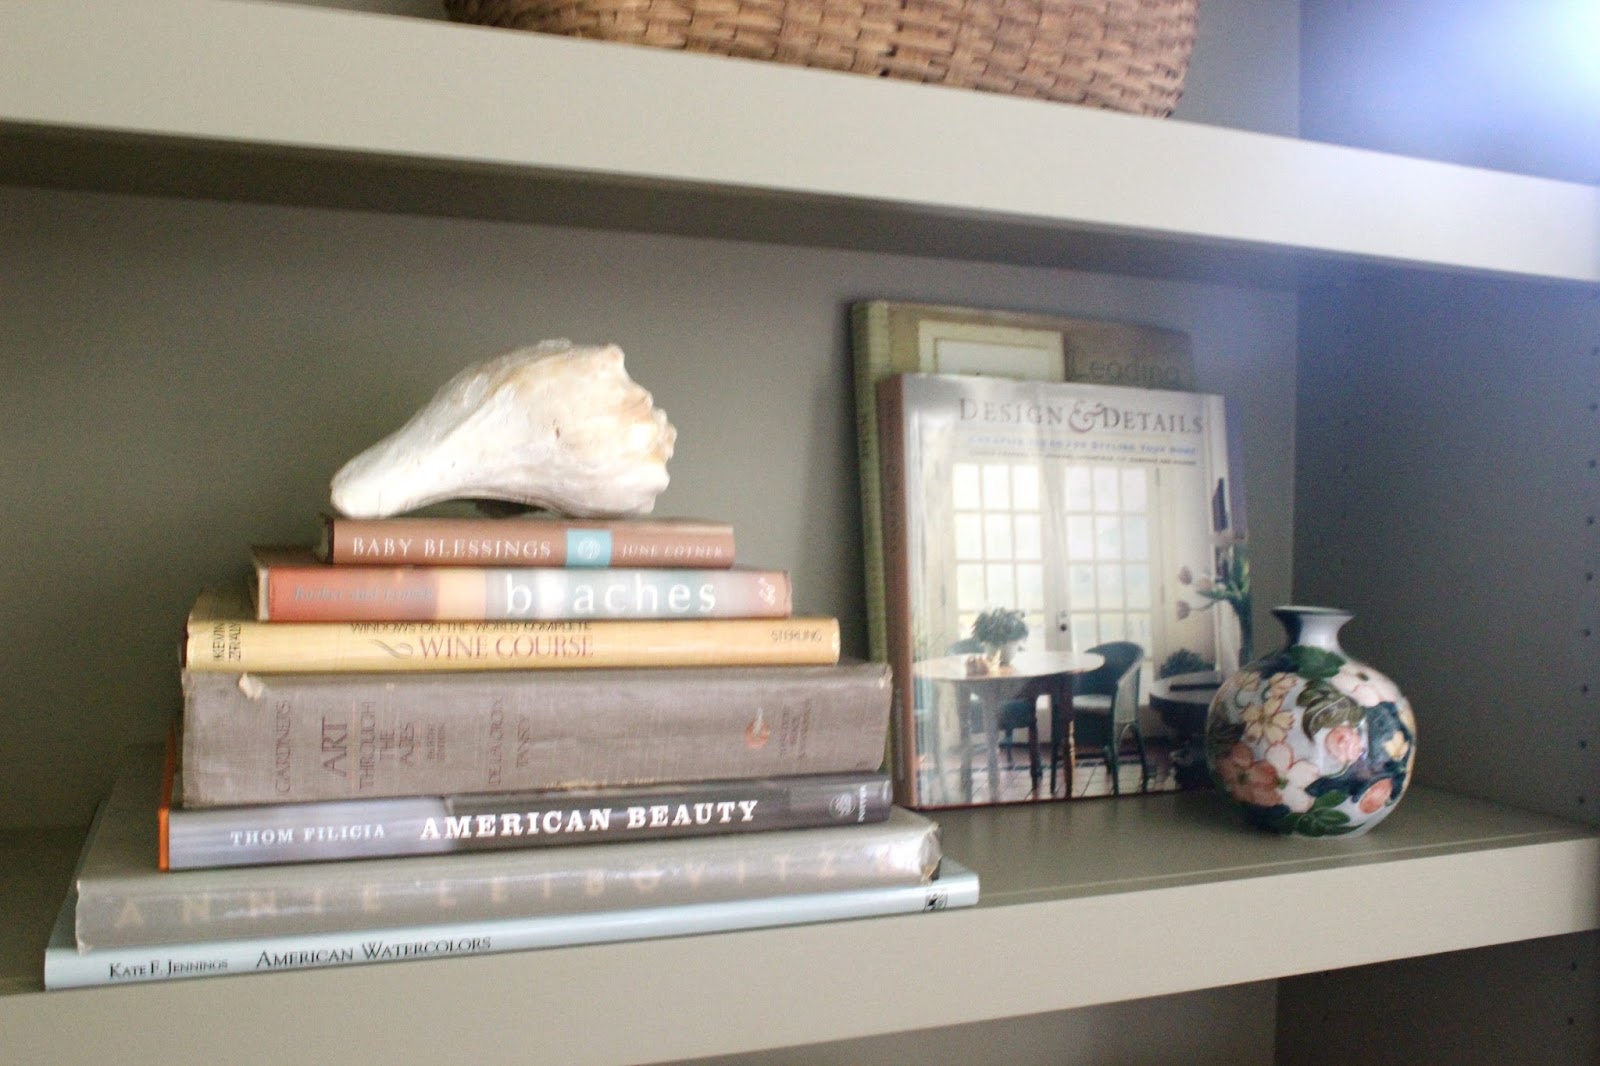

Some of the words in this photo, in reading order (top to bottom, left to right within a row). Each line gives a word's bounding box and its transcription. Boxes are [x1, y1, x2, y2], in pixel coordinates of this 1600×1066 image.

[959, 397, 1063, 425] DESIGN
[1068, 398, 1104, 433] &
[1103, 406, 1204, 433] DETAILS
[352, 537, 413, 558] BABY
[424, 537, 552, 560] BLESSINGS
[621, 543, 658, 559] JUNE
[505, 572, 717, 613] baches
[212, 622, 226, 662] KEVIN
[419, 635, 488, 660] WINE
[495, 634, 594, 659] COURSE
[321, 715, 349, 778] ART
[358, 699, 376, 791] THROUGH
[379, 728, 395, 761] THE
[229, 827, 294, 847] THOM
[303, 823, 387, 843] FILICIA
[419, 807, 613, 841] AMERICAN
[626, 799, 759, 830] BEAUTY
[108, 960, 147, 979] KATE
[149, 959, 163, 977] F.
[167, 957, 229, 977] JENNINGS
[255, 947, 354, 969] AMERICAN
[361, 935, 492, 960] WATERCOLORS
